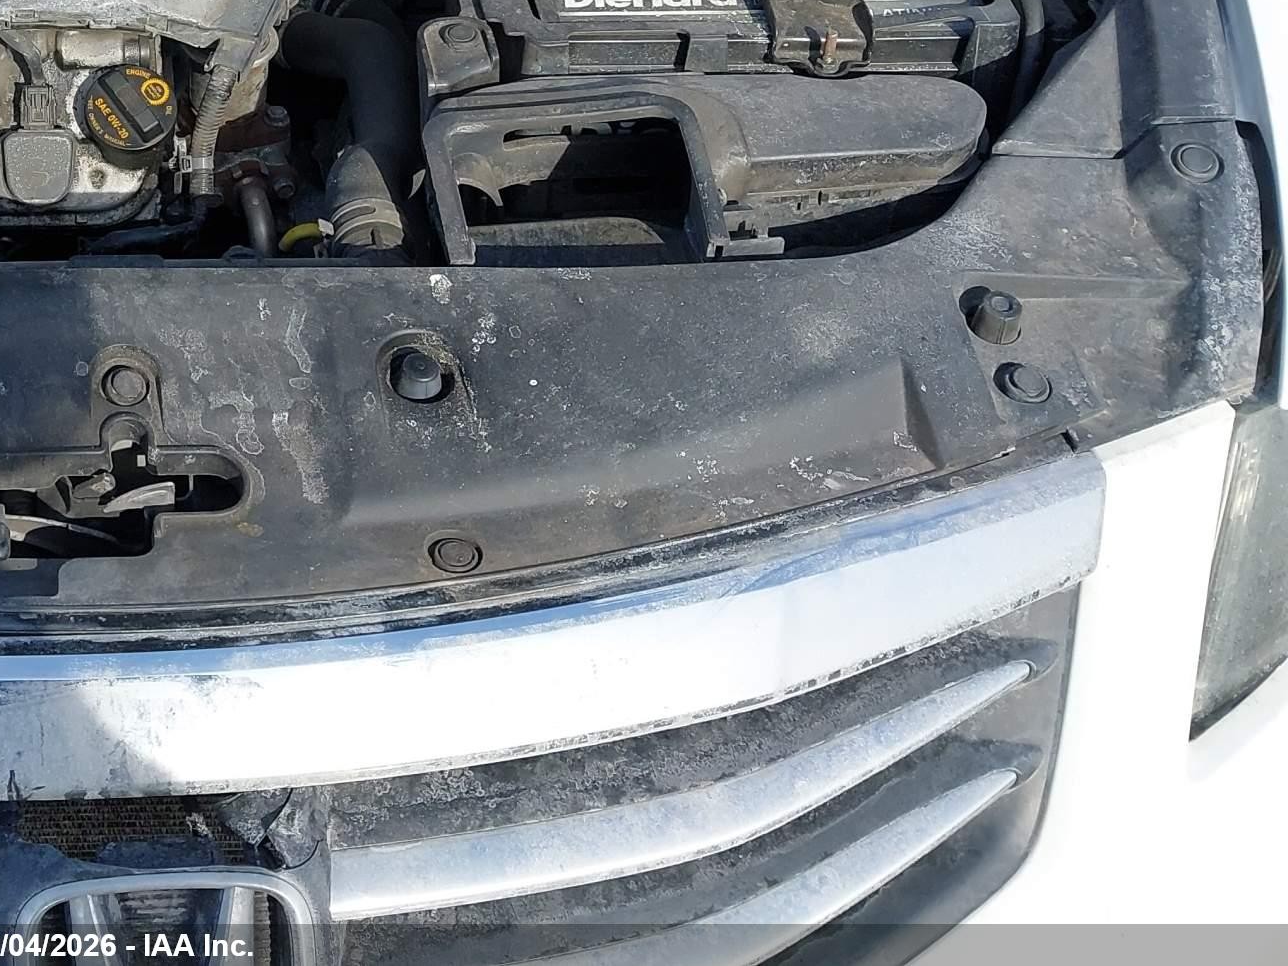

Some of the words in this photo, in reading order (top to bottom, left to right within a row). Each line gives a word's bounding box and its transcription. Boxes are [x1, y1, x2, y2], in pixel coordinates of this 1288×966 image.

[125, 68, 152, 80] ENGINE
[94, 97, 111, 116] SAE
[107, 114, 129, 139] 0W-20
